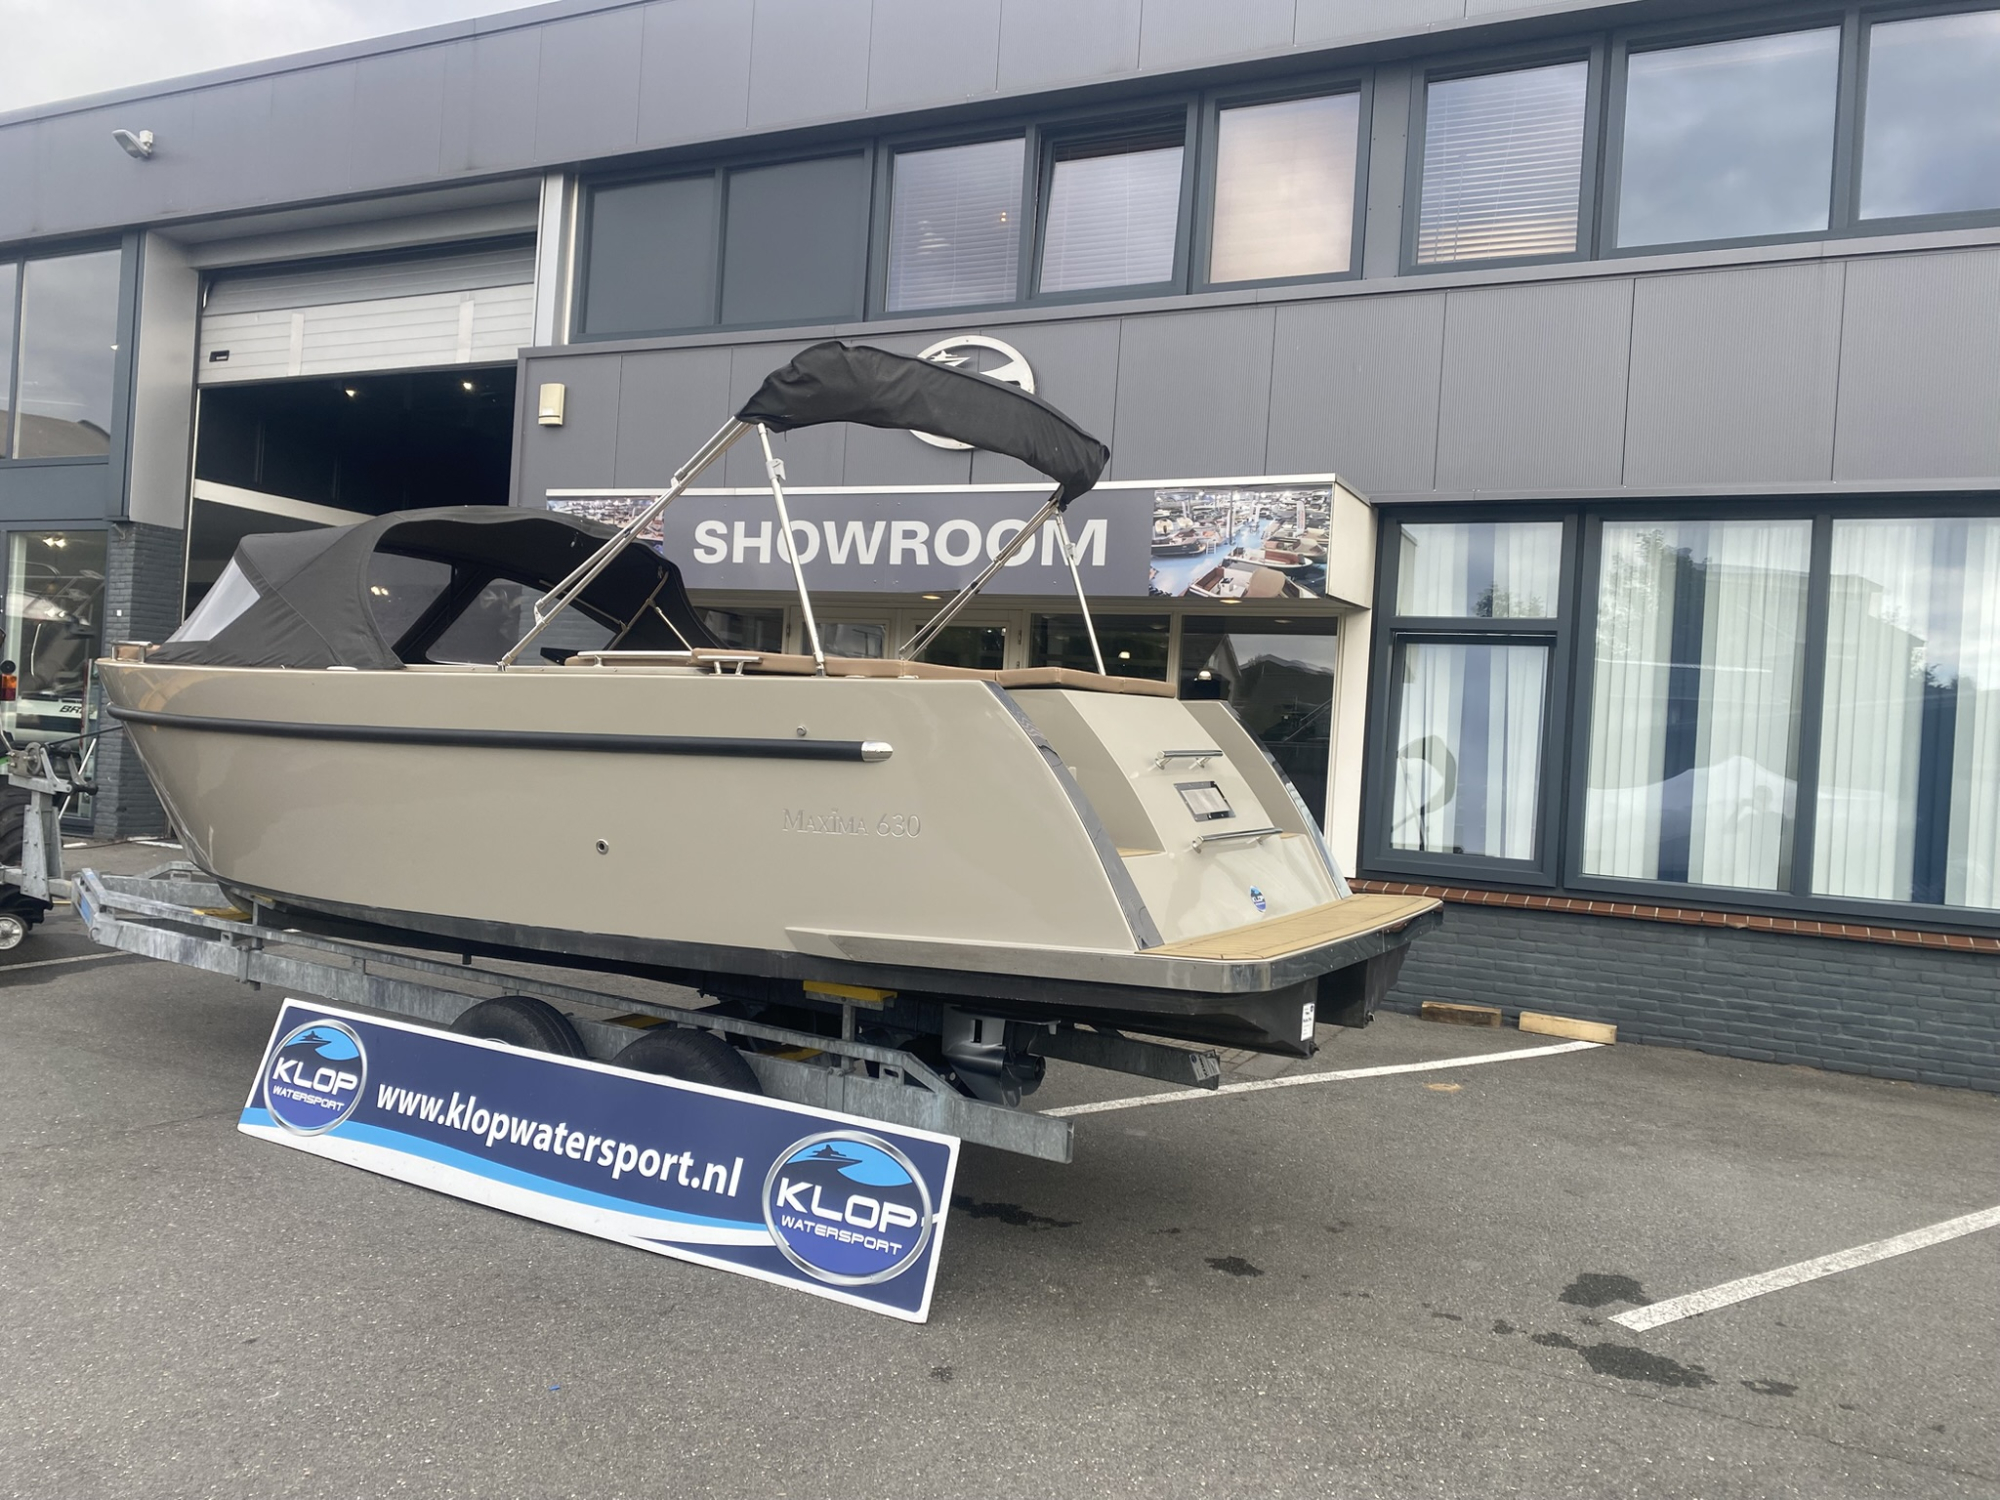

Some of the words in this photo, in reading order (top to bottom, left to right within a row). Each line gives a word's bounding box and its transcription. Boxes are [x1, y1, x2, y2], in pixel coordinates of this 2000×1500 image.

[693, 518, 1108, 567] SHOWROOM
[876, 812, 921, 838] 630
[272, 1057, 358, 1095] KLOP
[272, 1084, 345, 1112] WATERSPORT
[376, 1083, 744, 1198] www.klopwatersport.nl
[776, 1177, 918, 1233] KLOP
[781, 1214, 902, 1255] WATERSPORT
